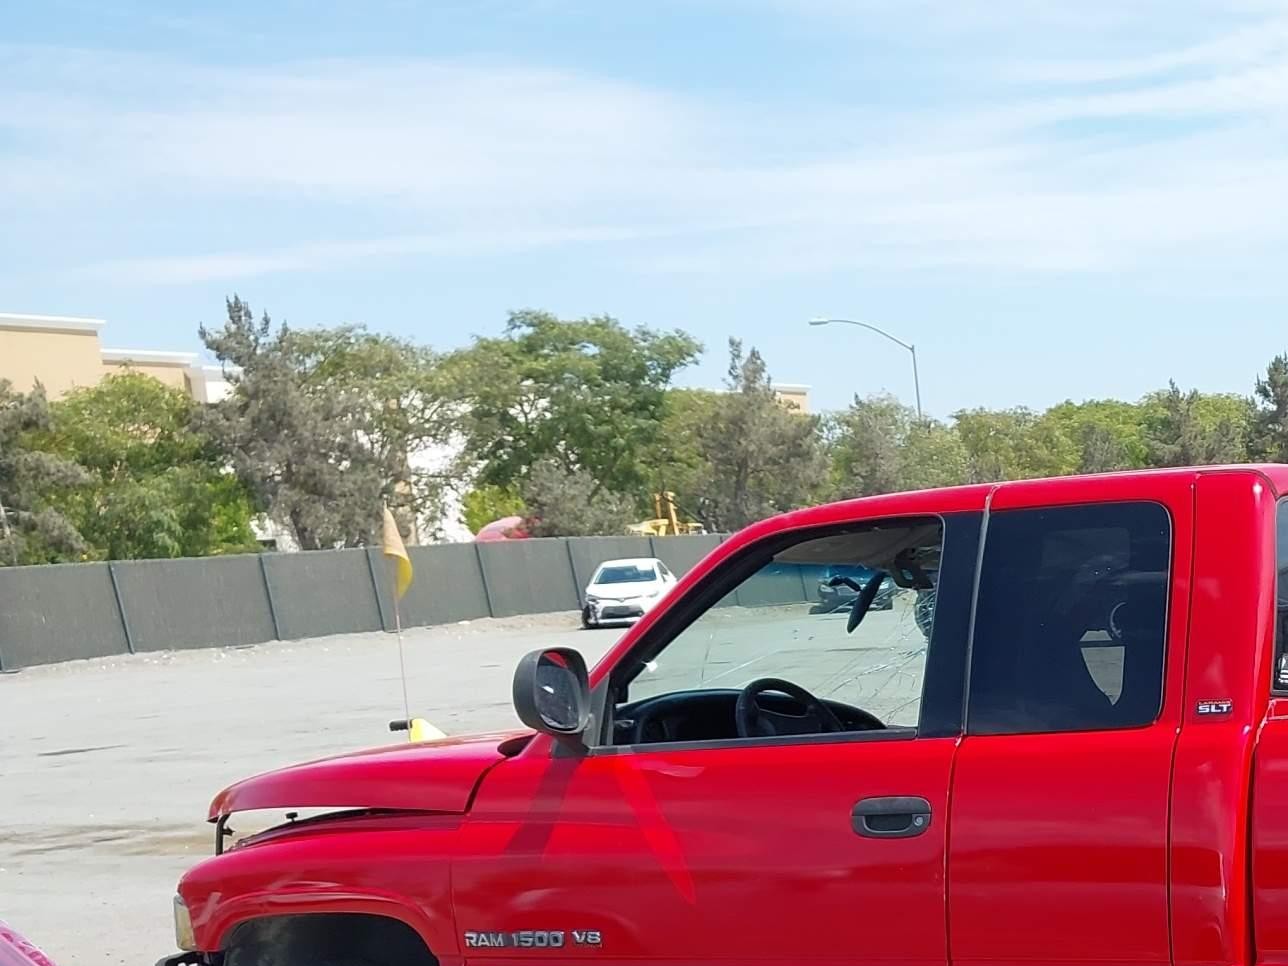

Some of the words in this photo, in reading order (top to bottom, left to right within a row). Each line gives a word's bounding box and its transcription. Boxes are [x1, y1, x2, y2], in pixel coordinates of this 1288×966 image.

[1198, 704, 1230, 713] SLT
[464, 931, 504, 947] RAM
[511, 931, 564, 947] 1500
[572, 930, 601, 944] V8
